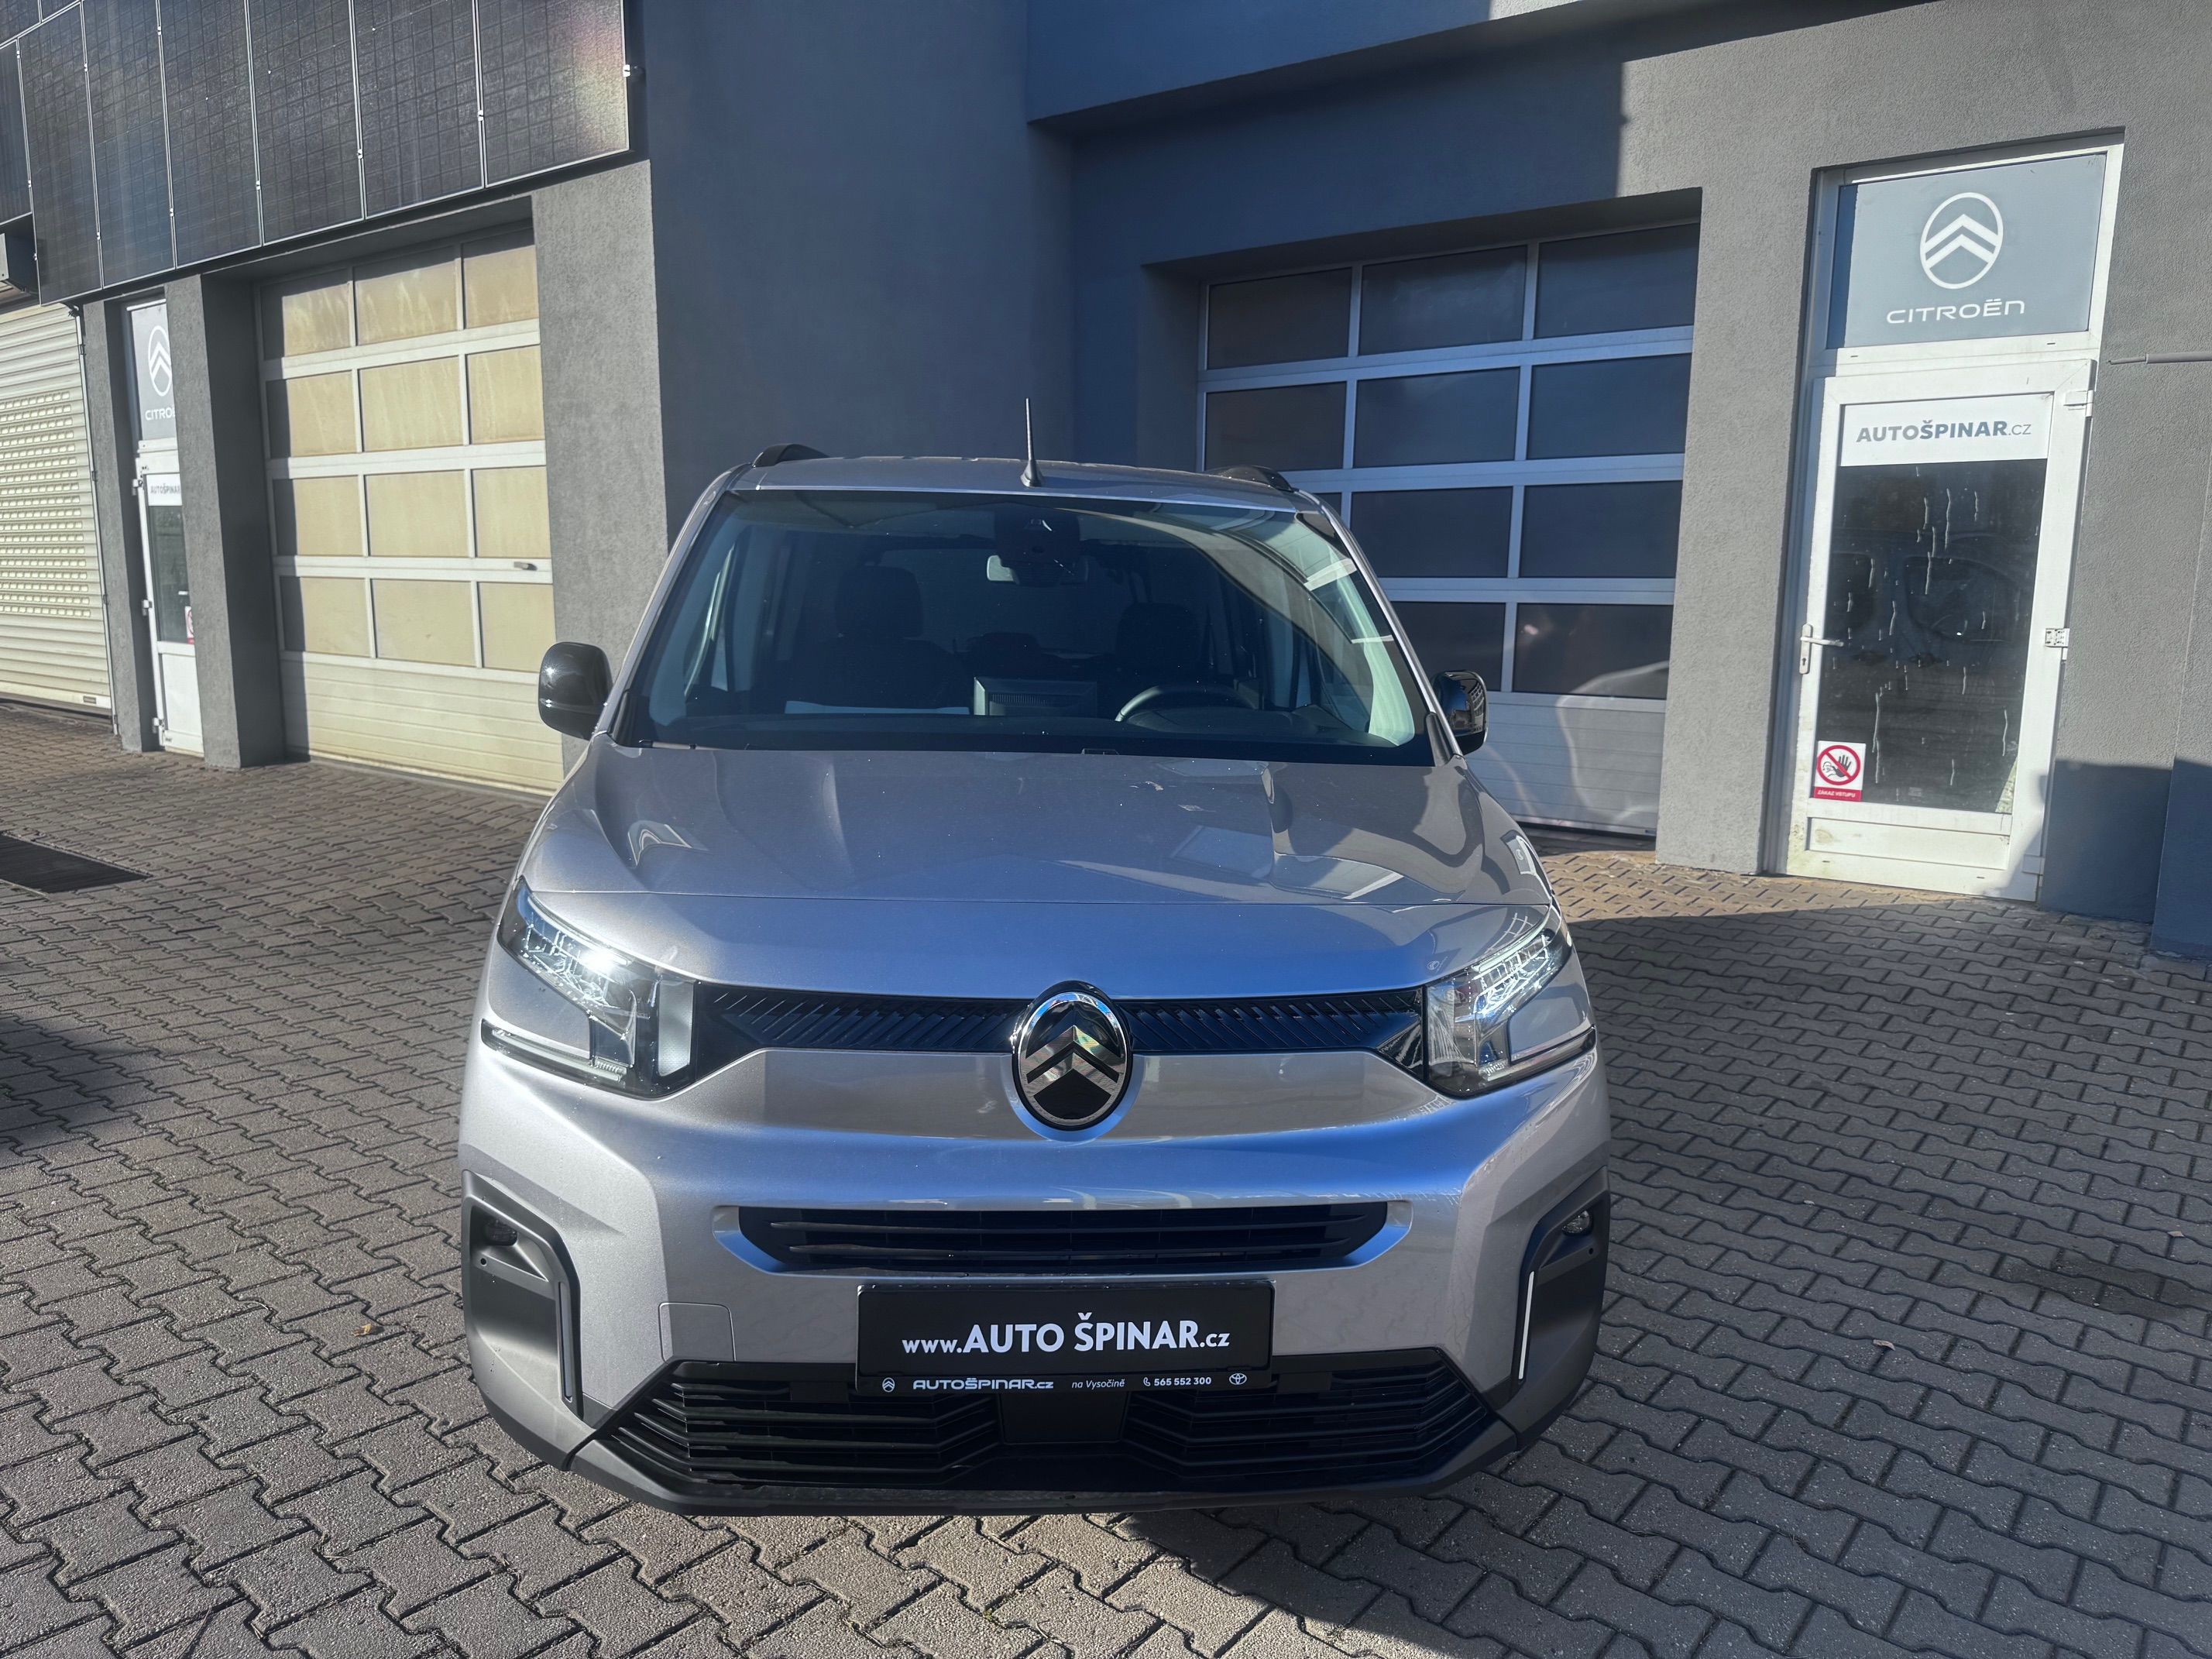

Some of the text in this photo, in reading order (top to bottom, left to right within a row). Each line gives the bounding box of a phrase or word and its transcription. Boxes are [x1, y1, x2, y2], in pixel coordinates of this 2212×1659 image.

[902, 1312, 1231, 1353] www.AUTO ŠPINAR.cz
[1086, 1378, 1125, 1389] Vysočině
[1153, 1378, 1171, 1386] 565
[1173, 1377, 1191, 1386] 552
[1194, 1376, 1211, 1386] 300
